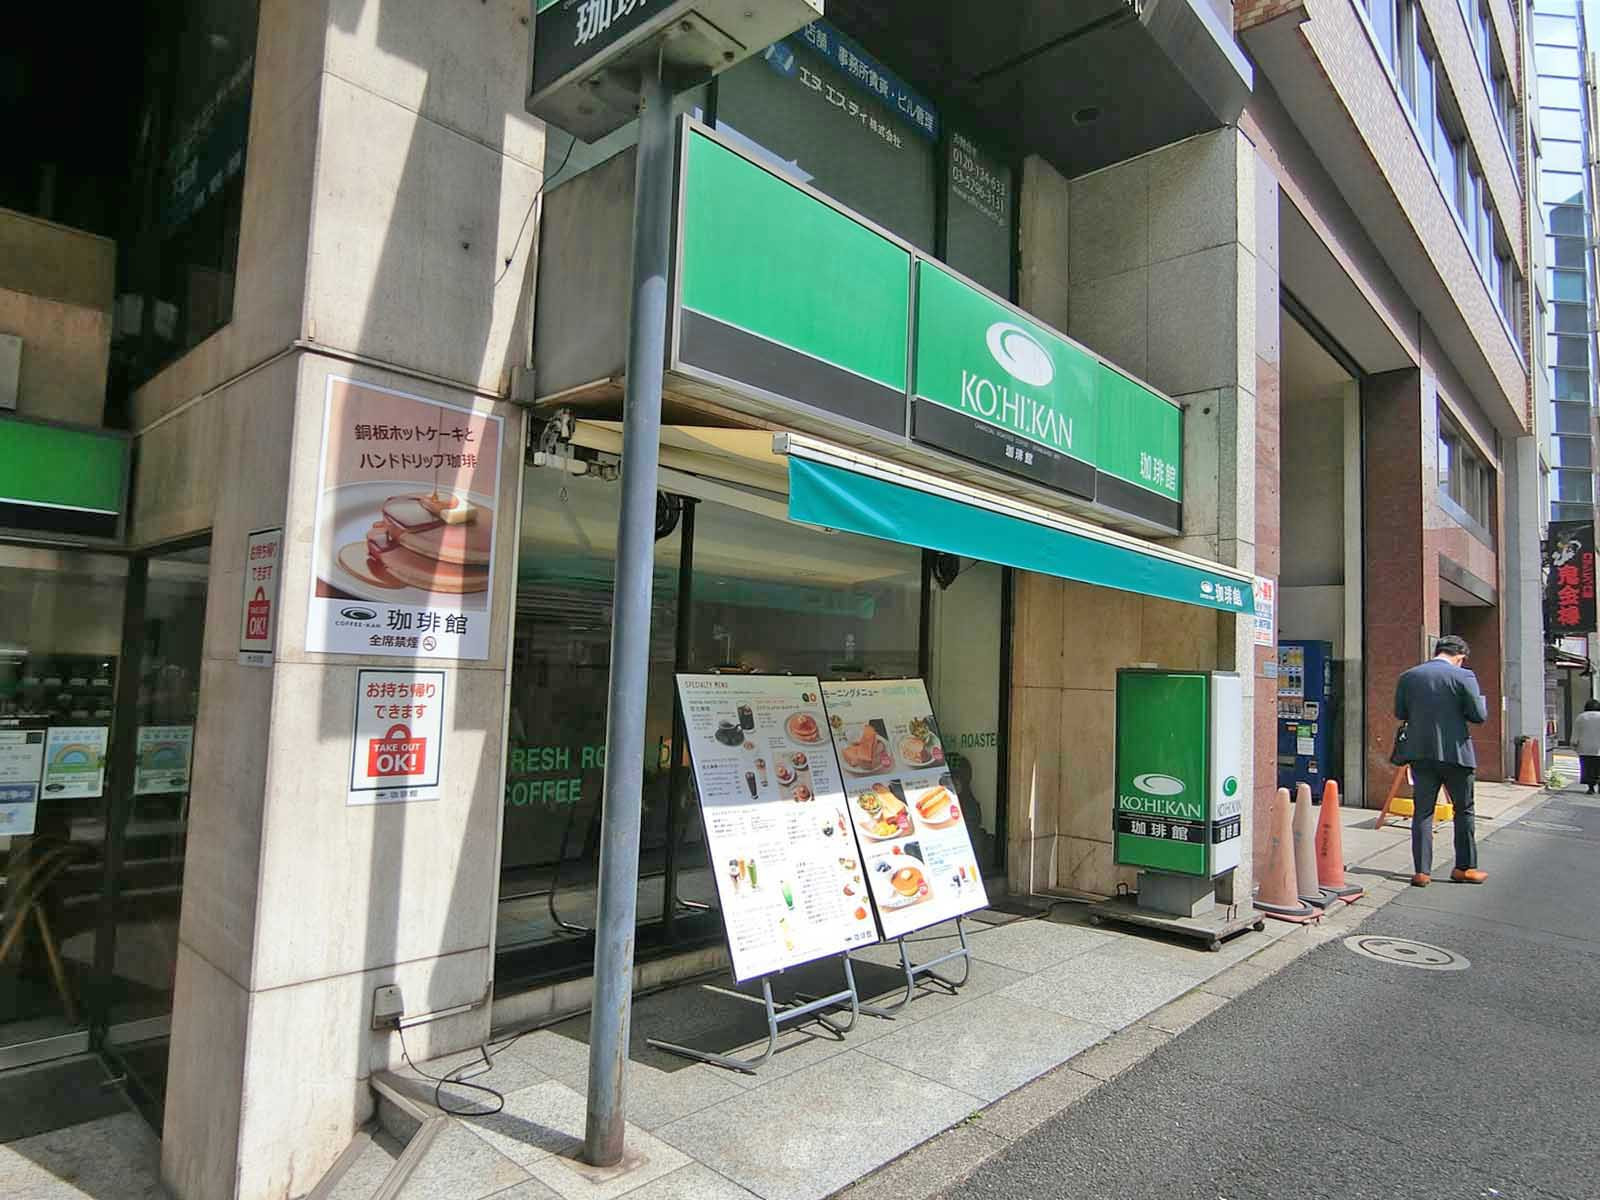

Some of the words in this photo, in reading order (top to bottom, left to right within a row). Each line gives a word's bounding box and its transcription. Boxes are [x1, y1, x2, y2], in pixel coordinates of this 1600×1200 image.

[355, 424, 475, 442] 銅板ホットケーキと
[360, 452, 477, 469] ハンドドリップ珈琲
[1139, 451, 1176, 491] 珈琲館
[386, 608, 469, 636] 珈琲館
[369, 634, 419, 650] 全席禁煙
[366, 681, 436, 699] お持ち帰り
[374, 703, 427, 720] できます
[374, 743, 399, 753] TAKE
[401, 743, 421, 752] OUT
[376, 753, 418, 773] OK!
[511, 746, 569, 773] RESH
[507, 778, 582, 806] OFFEE
[1131, 820, 1188, 841] 珈琲館
